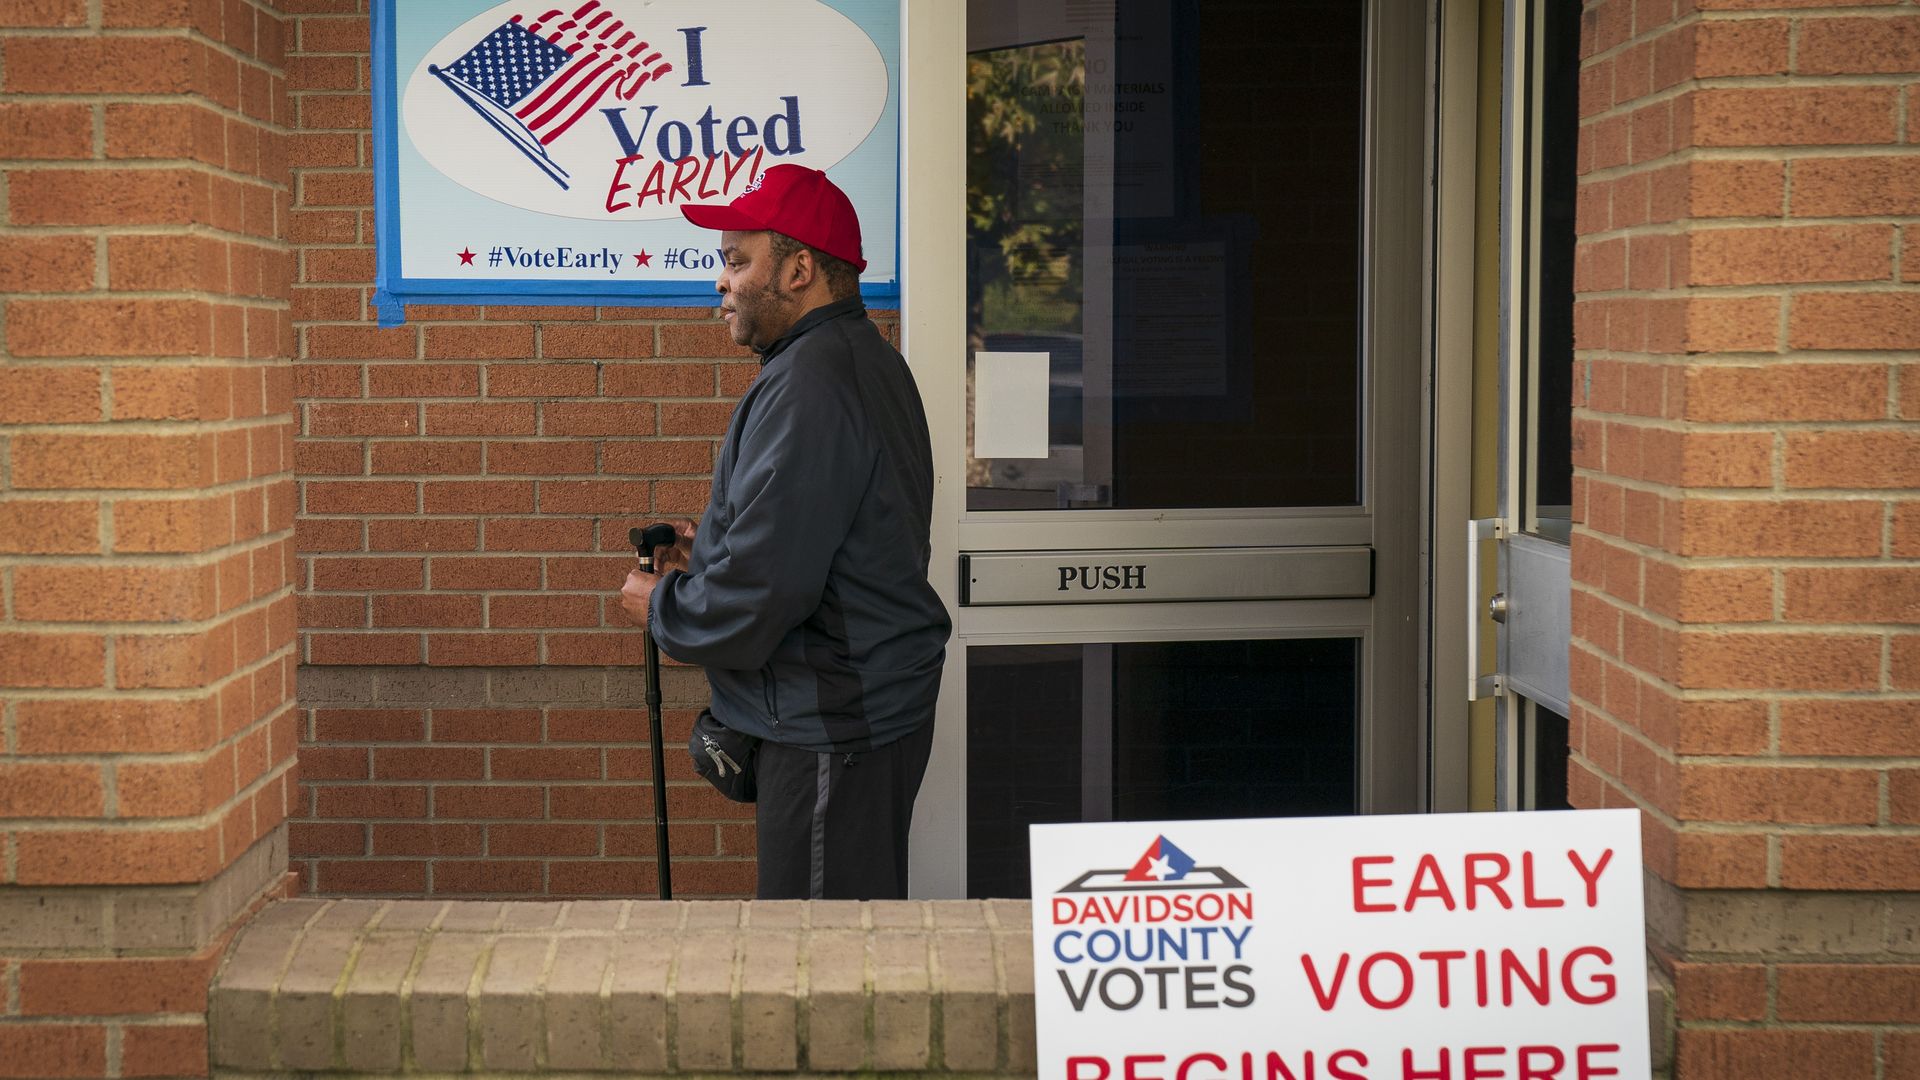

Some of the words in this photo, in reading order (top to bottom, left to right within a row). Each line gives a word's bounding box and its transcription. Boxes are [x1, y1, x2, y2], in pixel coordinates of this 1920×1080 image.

[677, 26, 711, 88] I
[1094, 82, 1166, 95] MATERIALS
[1105, 101, 1146, 113] INSIDE
[599, 96, 805, 164] Voted
[1053, 120, 1100, 133] THANK
[1104, 120, 1135, 132] YOU
[487, 245, 624, 275] #VoteEarly
[1057, 564, 1147, 591] PUSH
[1351, 847, 1614, 913] EARLY
[1052, 892, 1254, 926] DAVIDSON
[1053, 925, 1254, 965] COUNTY
[1056, 964, 1256, 1013] VOTES
[1299, 944, 1618, 1012] VOTING
